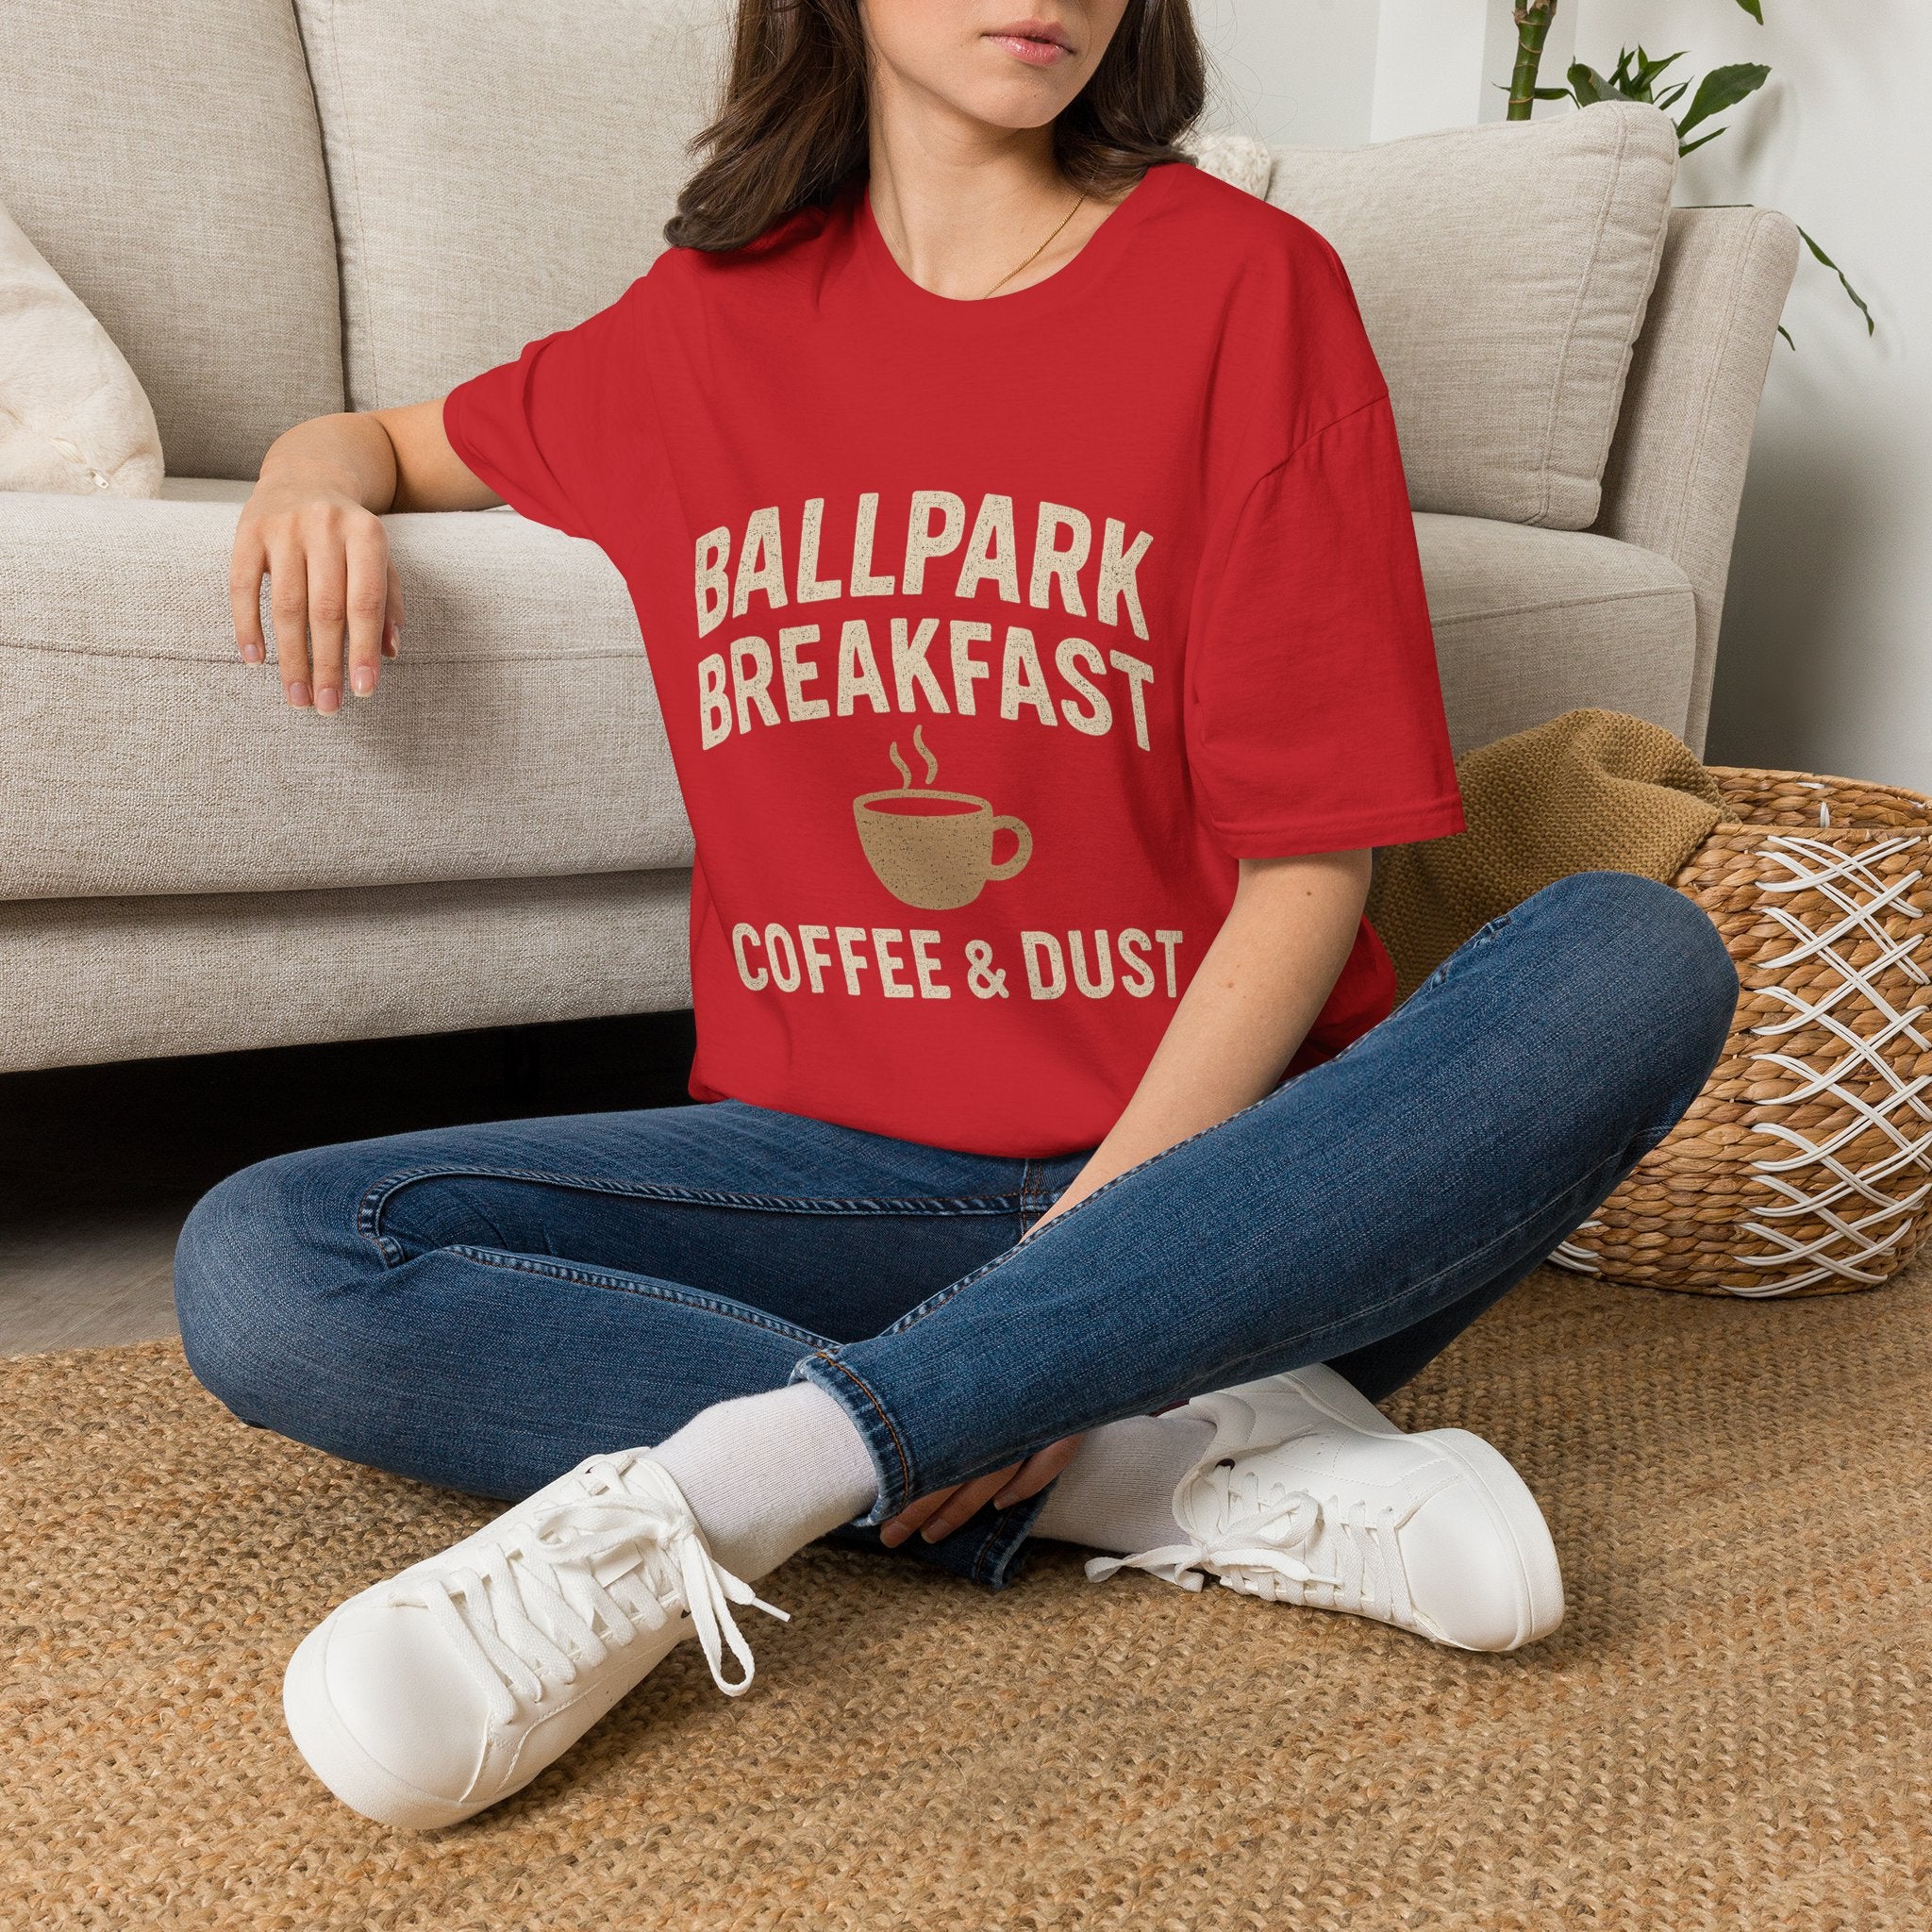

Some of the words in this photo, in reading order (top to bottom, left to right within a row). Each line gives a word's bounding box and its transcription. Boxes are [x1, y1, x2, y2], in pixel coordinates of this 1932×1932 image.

[694, 490, 1154, 640] BALLPARK
[697, 617, 1155, 752] BREAKFAST
[732, 923, 951, 999] COFFEE
[964, 939, 1009, 1000] &
[1021, 928, 1183, 1000] DUST
